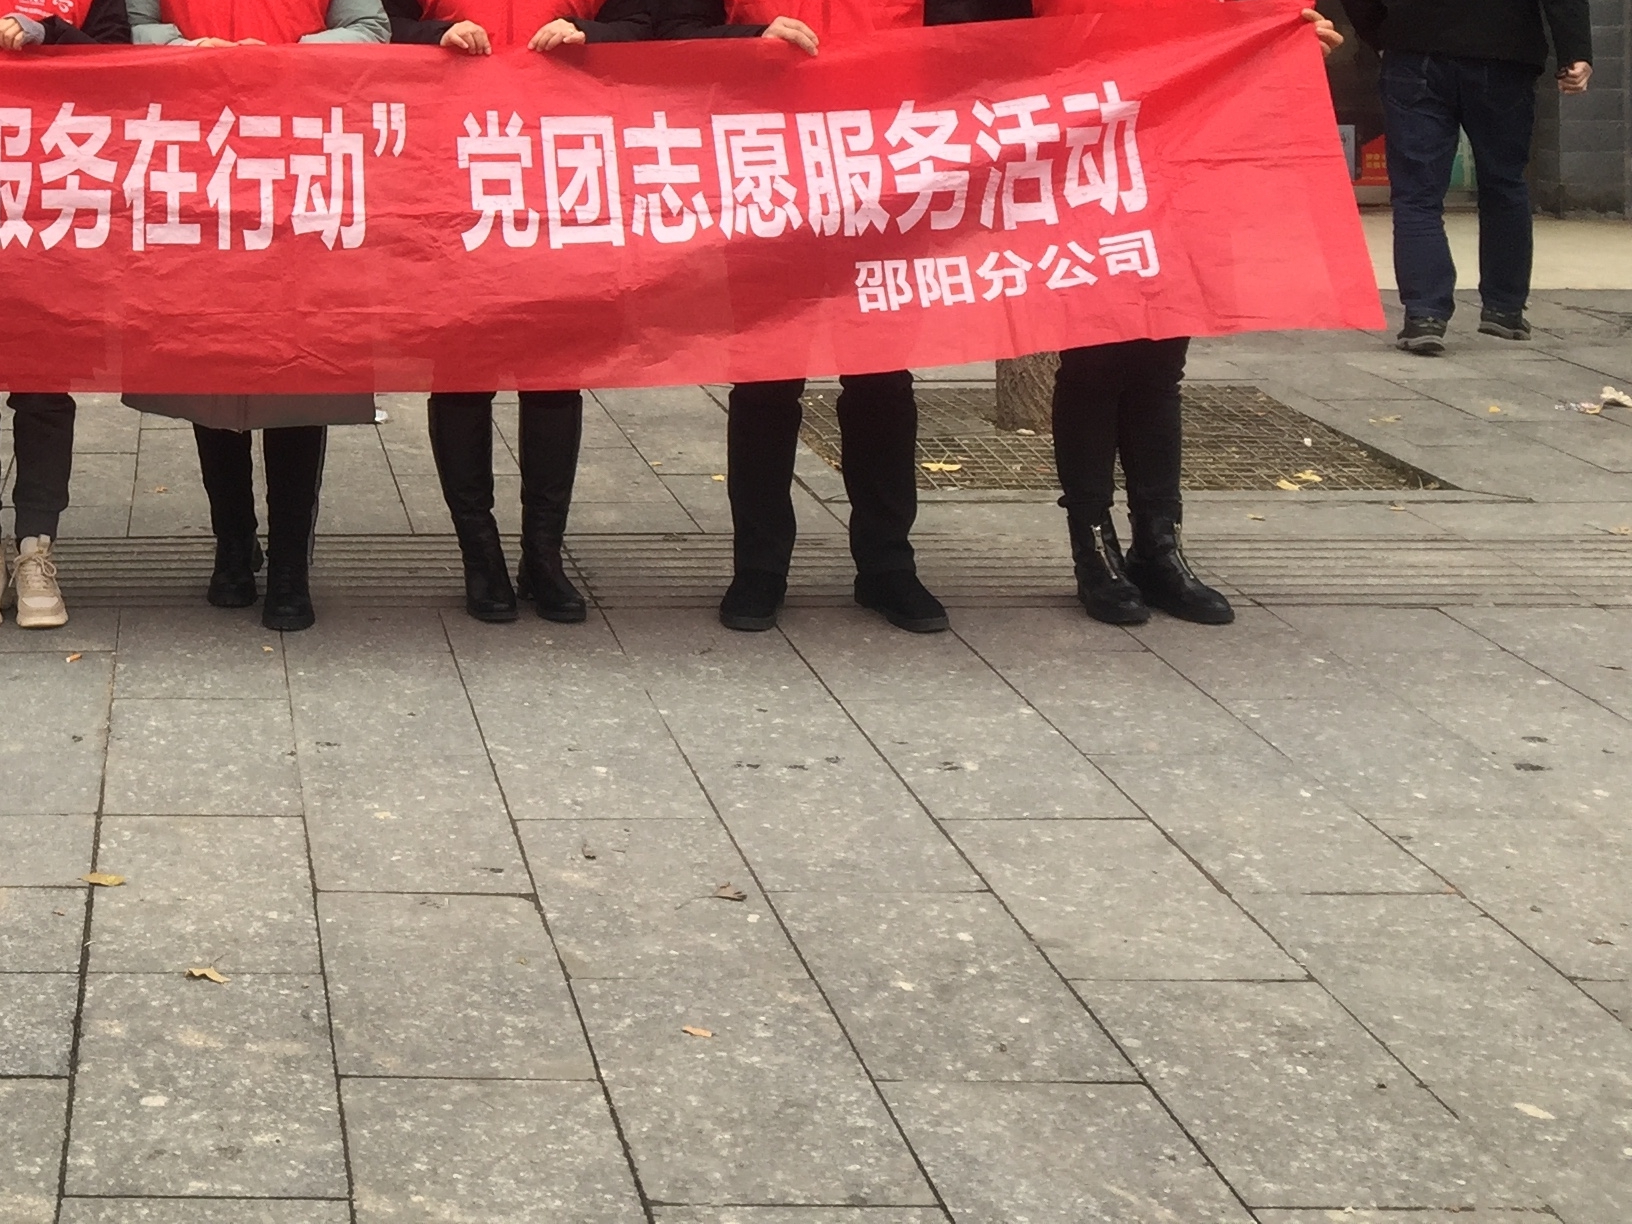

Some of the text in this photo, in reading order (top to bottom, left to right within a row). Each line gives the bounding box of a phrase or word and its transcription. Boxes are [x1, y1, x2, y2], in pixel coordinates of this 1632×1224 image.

[457, 80, 1147, 252] 党团志愿服务活动
[854, 229, 1161, 314] 邵阳分公司
